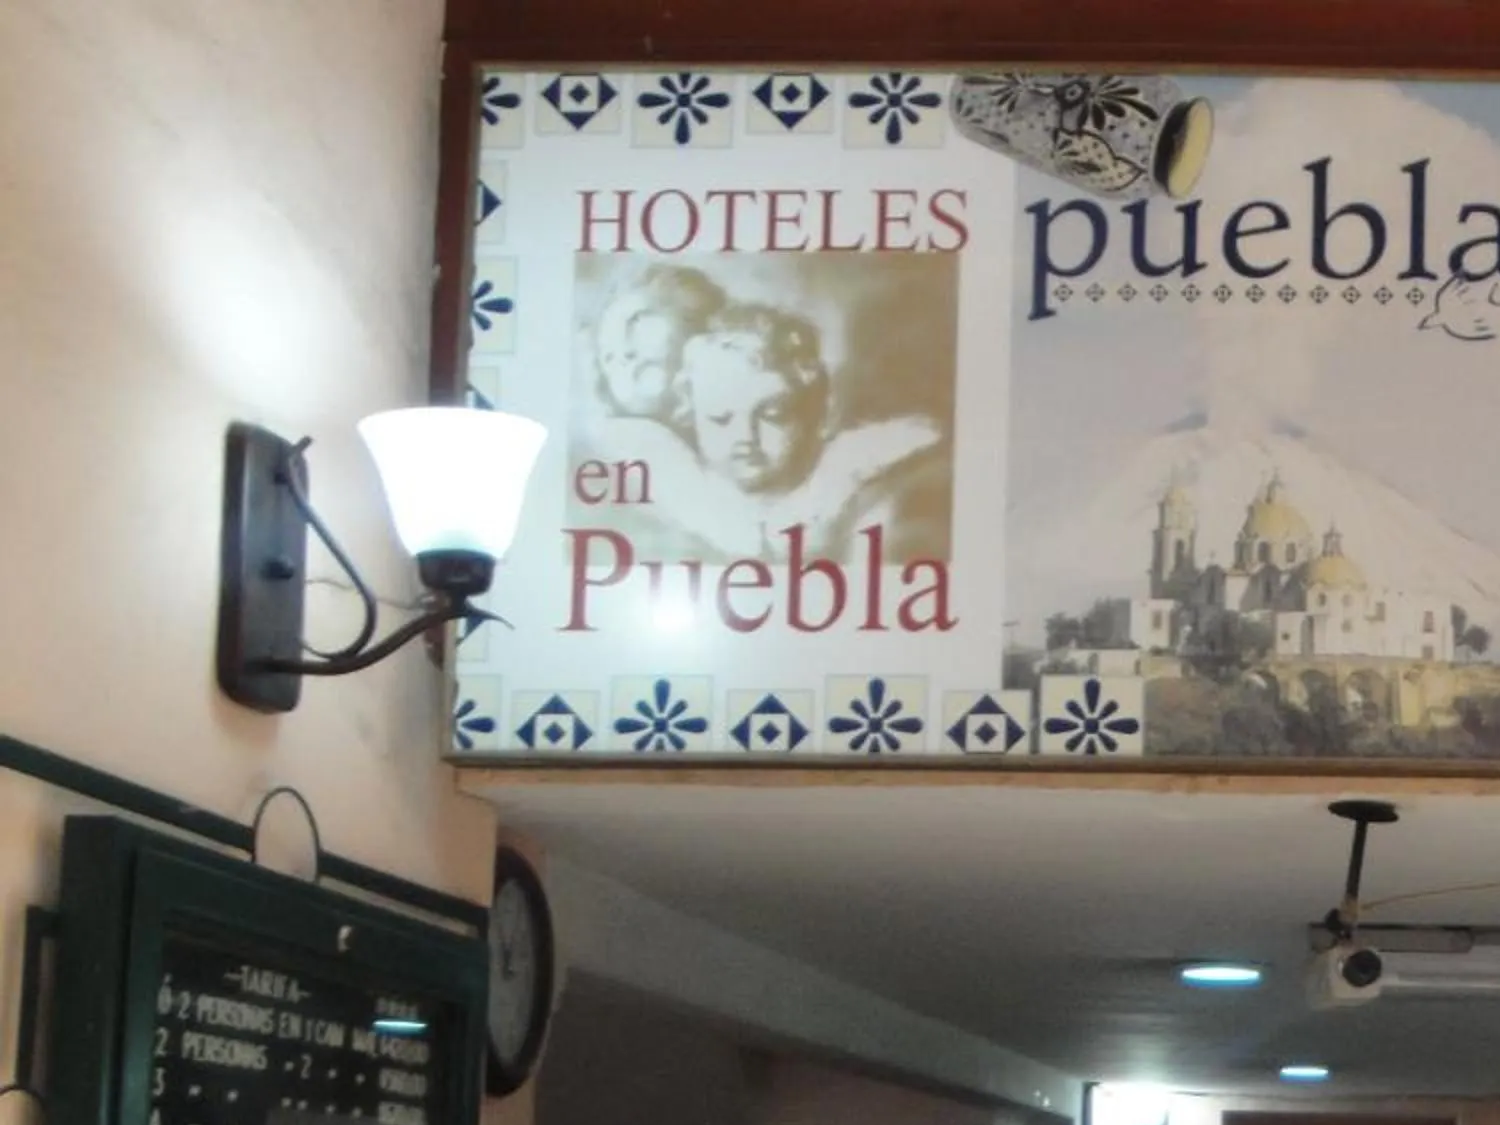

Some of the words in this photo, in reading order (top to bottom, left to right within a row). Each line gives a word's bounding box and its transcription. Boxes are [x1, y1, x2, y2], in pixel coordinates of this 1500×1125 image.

[573, 189, 971, 253] HOTELES
[573, 456, 654, 505] en
[556, 522, 961, 634] Puebla
